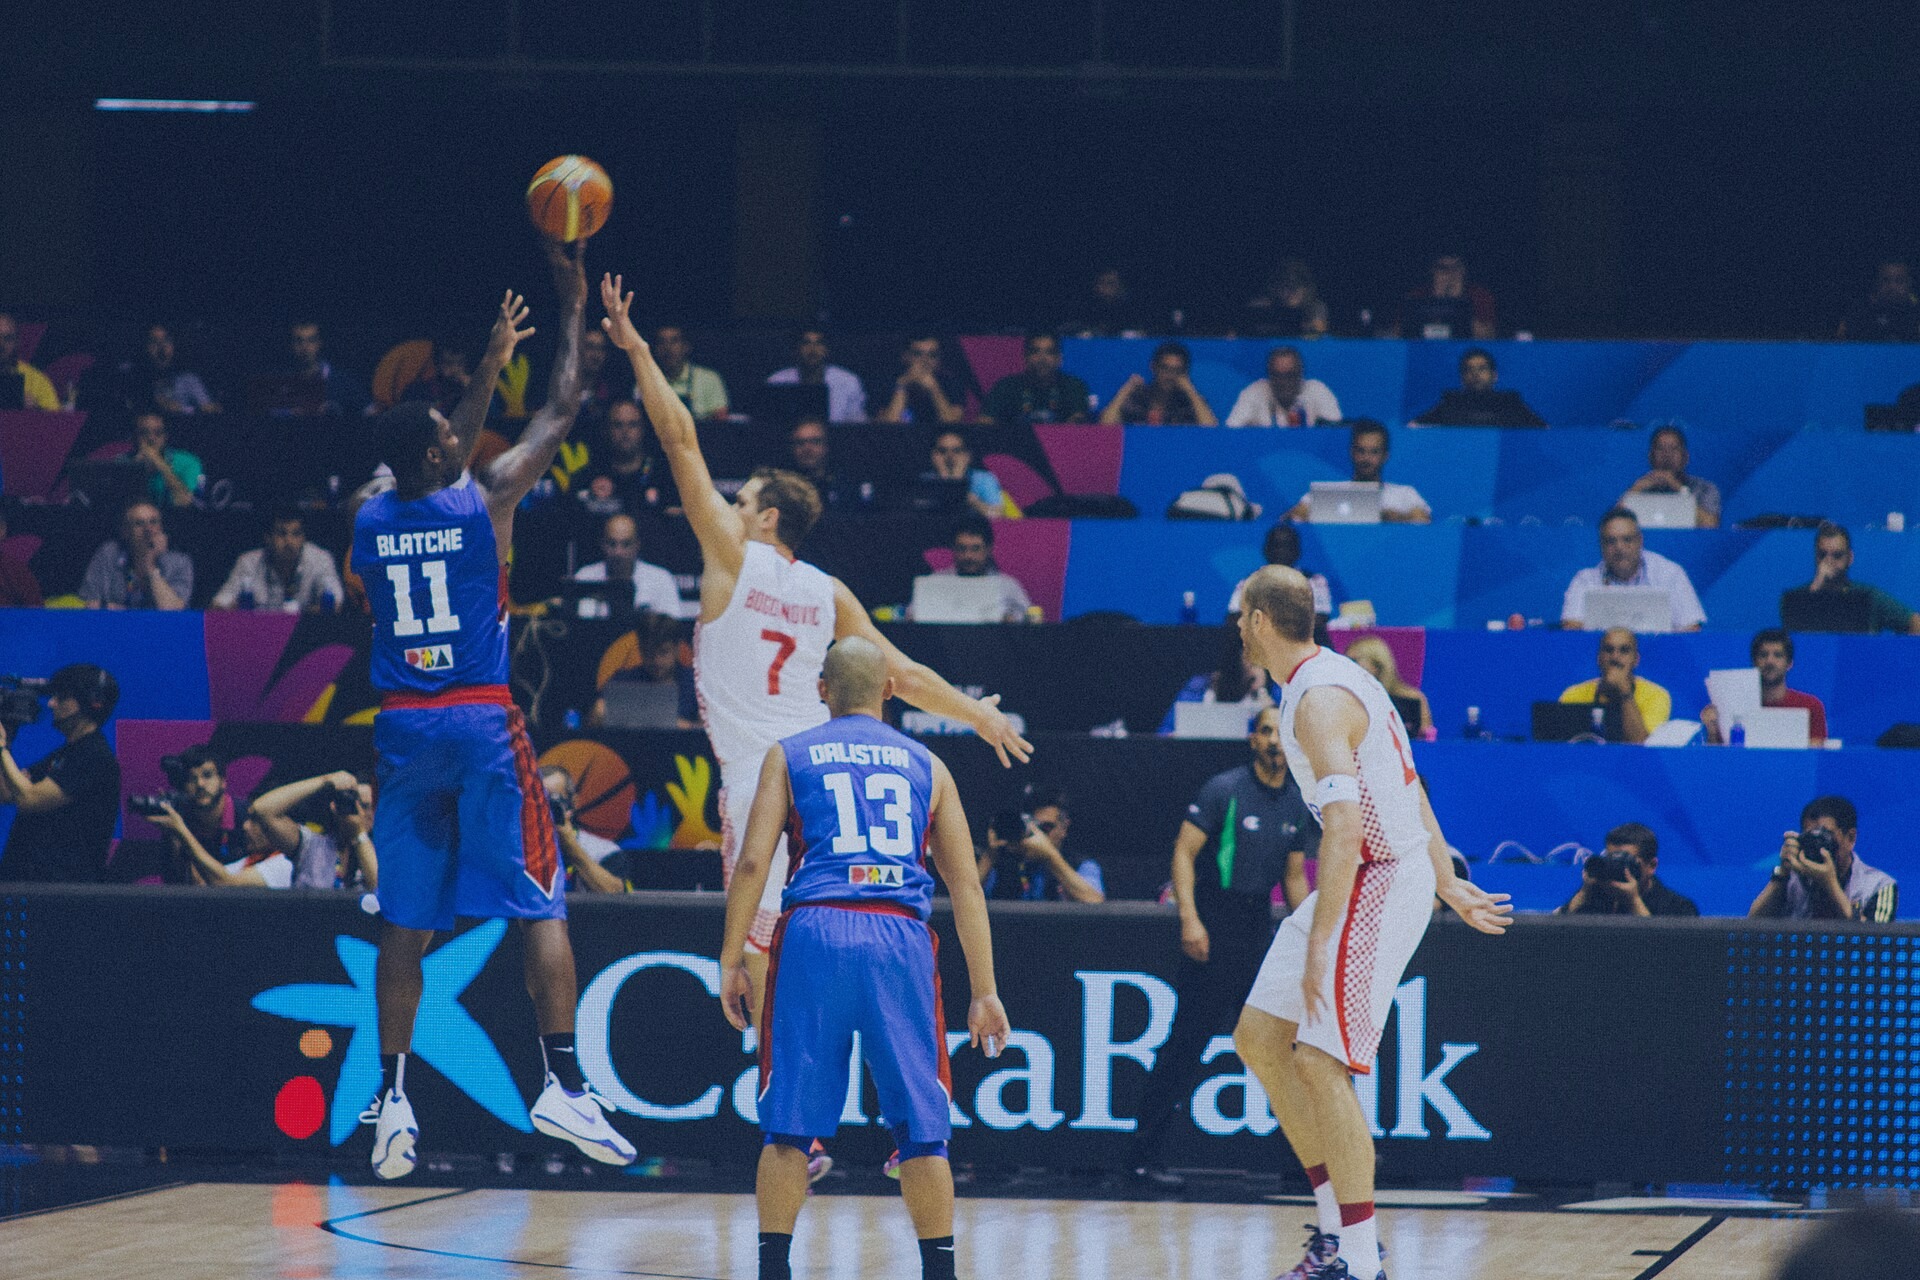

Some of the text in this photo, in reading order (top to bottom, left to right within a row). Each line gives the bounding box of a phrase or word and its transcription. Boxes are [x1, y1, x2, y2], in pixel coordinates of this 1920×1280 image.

[377, 528, 463, 557] BLATCHE
[386, 560, 461, 636] 11
[760, 628, 797, 695] 7
[809, 742, 910, 769] DALISTAN
[823, 772, 914, 856] 13
